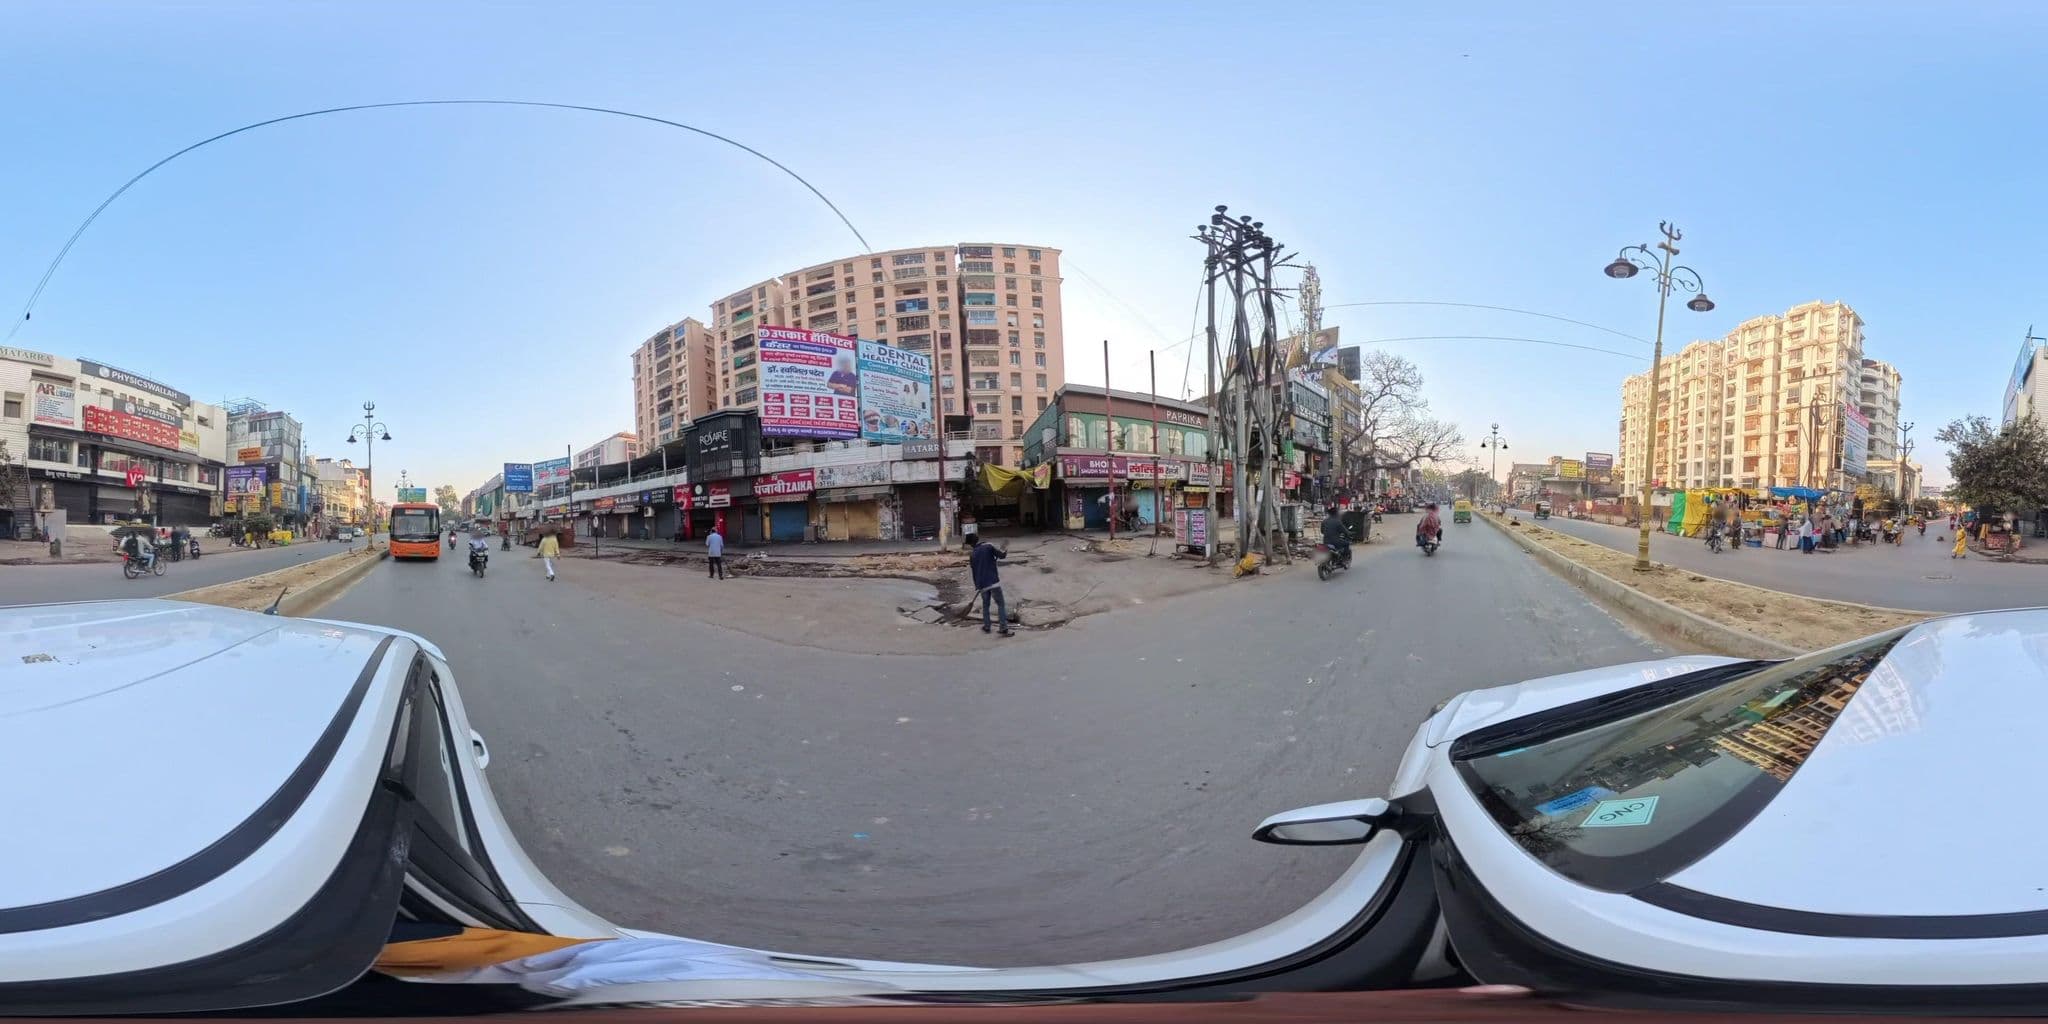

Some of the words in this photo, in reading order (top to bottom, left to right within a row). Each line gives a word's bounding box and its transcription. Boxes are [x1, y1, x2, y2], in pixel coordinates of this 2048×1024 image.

[771, 329, 807, 341] उपकार
[862, 352, 898, 366] HEALTH
[900, 361, 928, 374] CLINIC
[877, 346, 927, 367] DENTAL
[112, 371, 177, 399] PHYSICSWALLAH
[136, 405, 176, 422] VIDYAPEETH
[1166, 410, 1202, 426] PAPRIKA
[699, 429, 728, 446] ROSAIRE
[904, 444, 945, 453] MATARR
[1089, 460, 1117, 469] BHOA
[786, 480, 813, 492] ZAIKA
[1599, 801, 1645, 822] CNG
